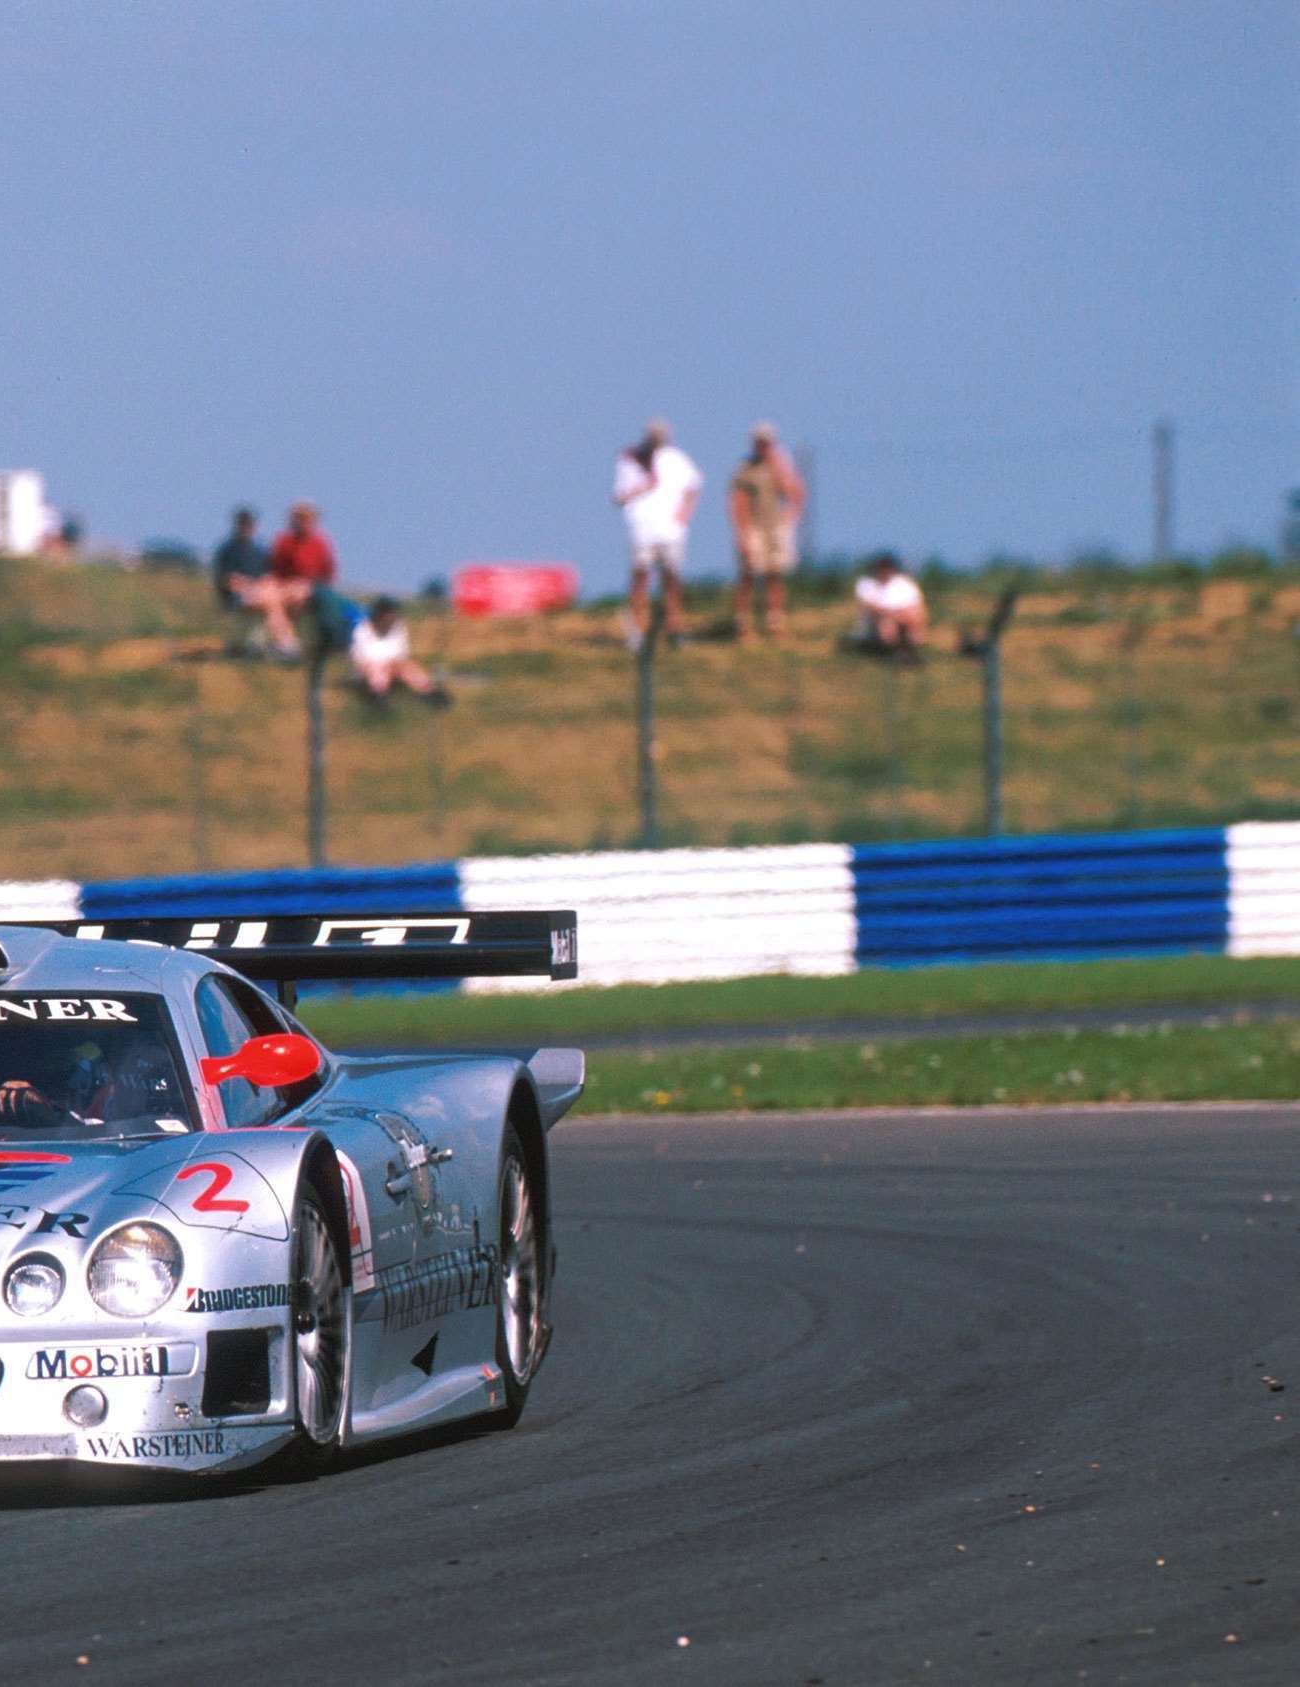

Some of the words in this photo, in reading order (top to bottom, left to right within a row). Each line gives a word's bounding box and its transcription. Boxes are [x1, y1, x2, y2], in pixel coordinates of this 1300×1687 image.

[177, 1163, 250, 1212] 2
[36, 1347, 139, 1378] Mobil
[87, 1432, 225, 1458] WARSTEINER
